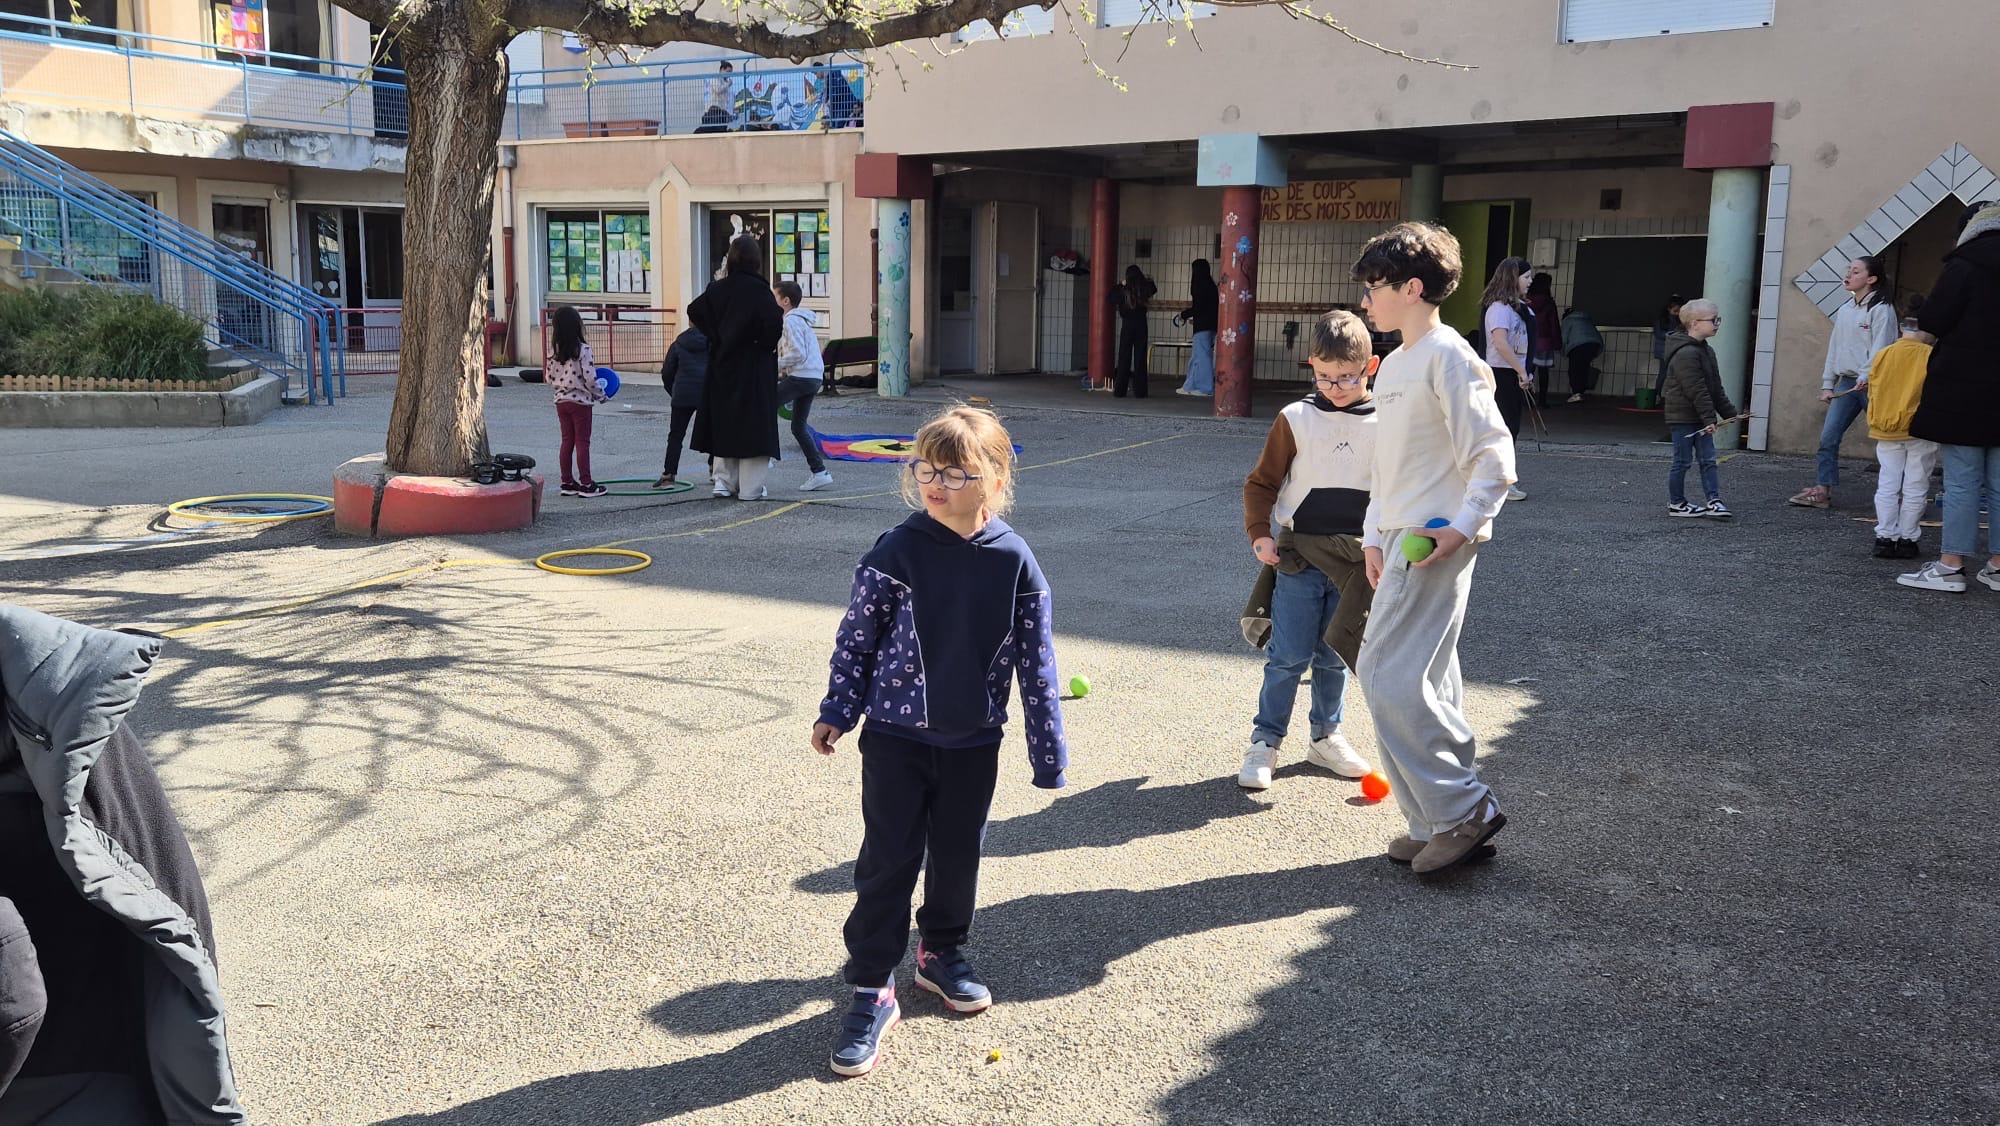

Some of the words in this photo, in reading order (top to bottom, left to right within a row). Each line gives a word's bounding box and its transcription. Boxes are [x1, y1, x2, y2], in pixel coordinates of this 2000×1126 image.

[1262, 186, 1280, 201] AS
[1287, 183, 1304, 200] DE
[1313, 181, 1356, 200] COUPS
[1260, 203, 1281, 221] AIS
[1286, 202, 1312, 221] DES
[1316, 202, 1350, 220] MOTS
